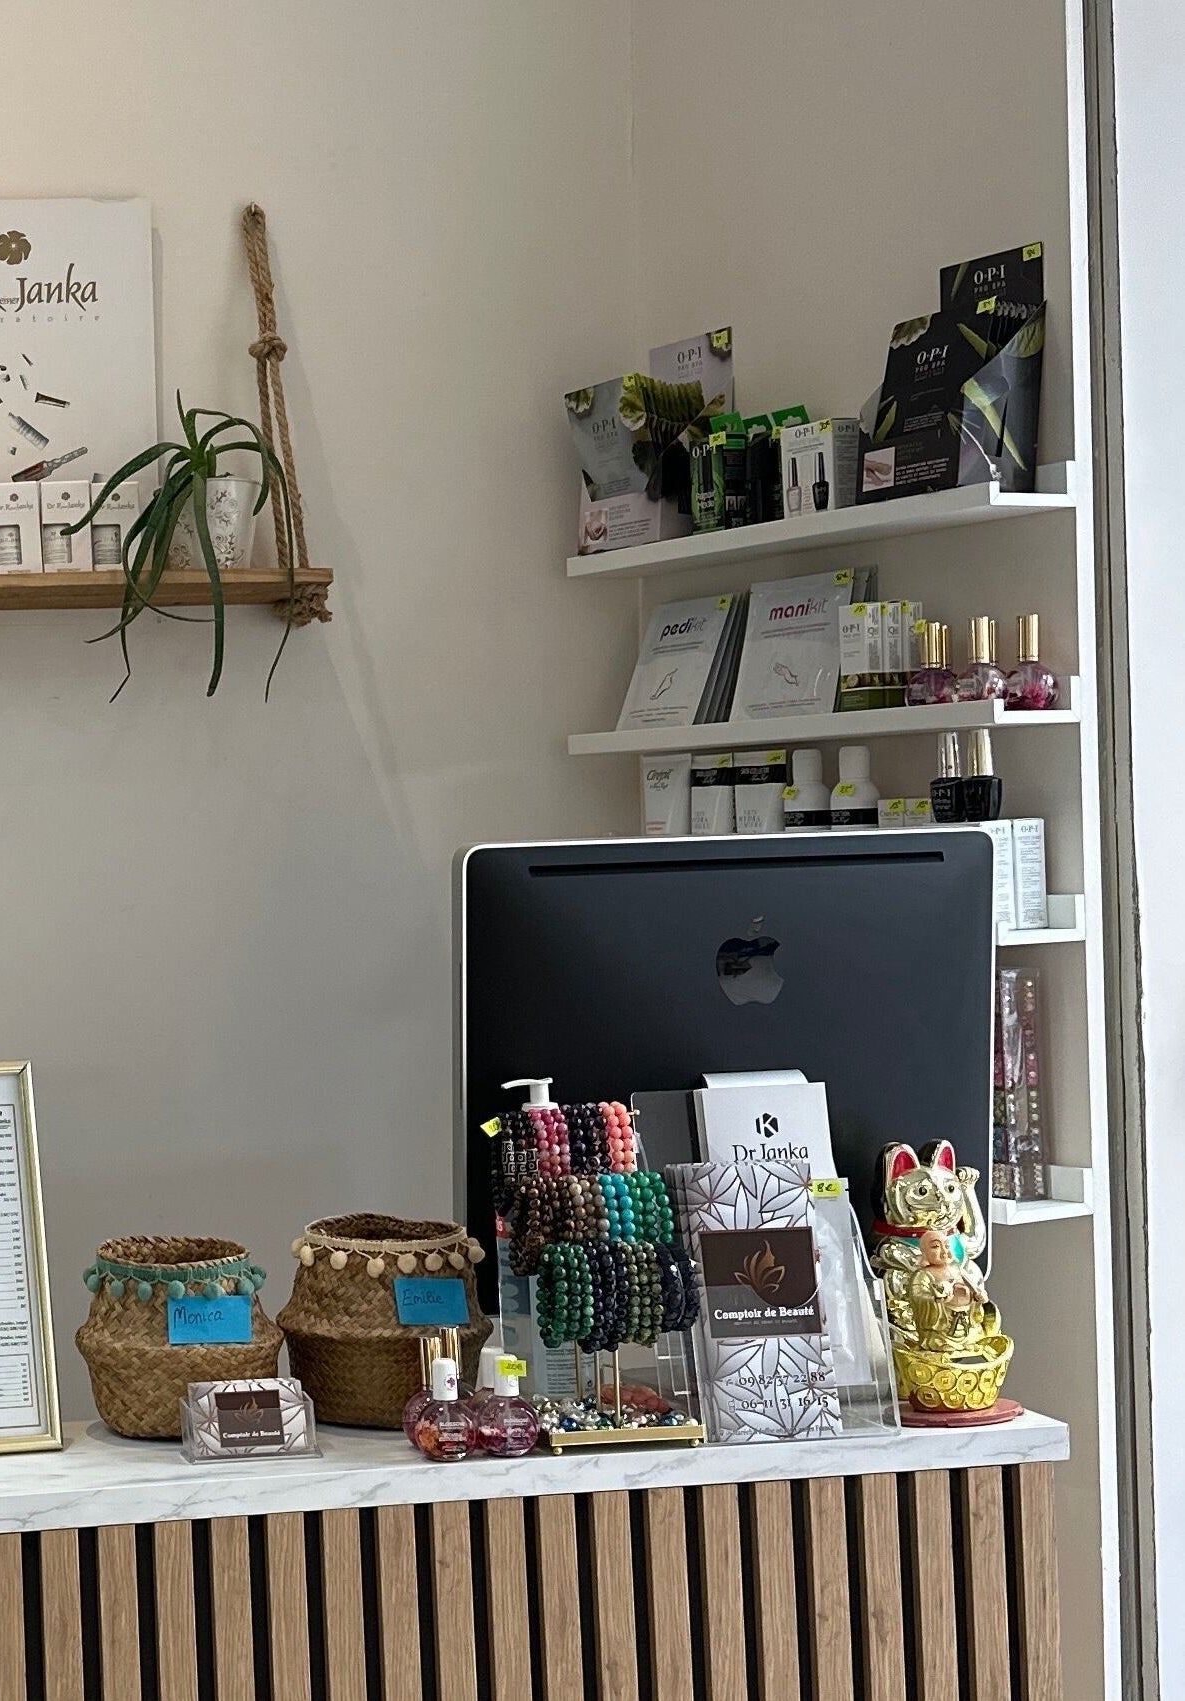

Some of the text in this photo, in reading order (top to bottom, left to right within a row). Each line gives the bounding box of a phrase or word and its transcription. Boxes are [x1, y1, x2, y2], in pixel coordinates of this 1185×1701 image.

[15, 263, 99, 312] Janka
[769, 599, 827, 621] manikit
[660, 617, 707, 641] pedikit
[732, 1142, 809, 1162] Dr Janka
[402, 1289, 444, 1306] Emilie
[173, 1305, 225, 1326] Monica
[714, 1305, 814, 1321] Comptoir de Beauté
[739, 1376, 755, 1388] 09
[759, 1374, 773, 1385] 82
[776, 1374, 789, 1386] 37
[793, 1374, 807, 1383] 22
[811, 1372, 826, 1382] 88
[741, 1399, 757, 1409] 06
[780, 1398, 791, 1409] 31
[798, 1396, 811, 1407] 16
[817, 1396, 828, 1407] 15
[223, 1431, 250, 1439] Comptoir
